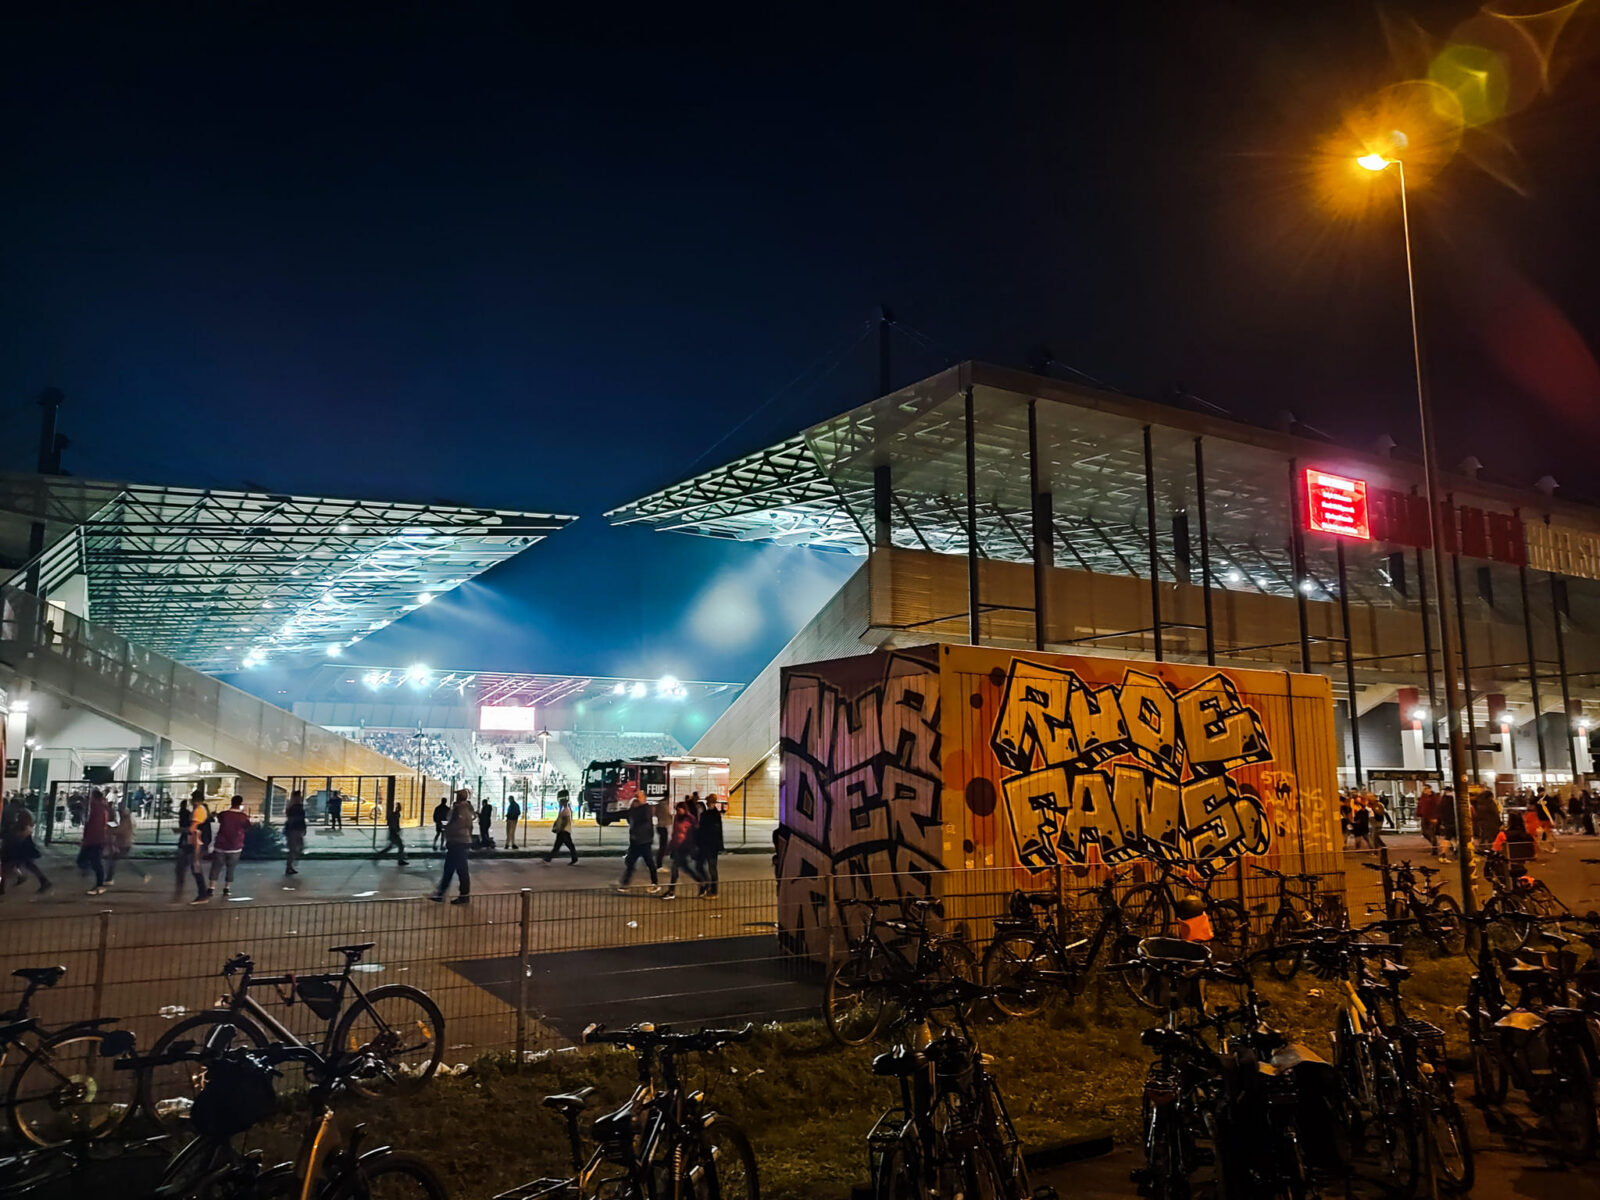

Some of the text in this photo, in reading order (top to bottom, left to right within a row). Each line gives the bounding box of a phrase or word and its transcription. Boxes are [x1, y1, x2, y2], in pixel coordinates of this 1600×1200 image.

[780, 653, 941, 778] NUR
[990, 657, 1274, 778] RUDE
[780, 750, 941, 857] DER
[1001, 763, 1269, 875] FANS
